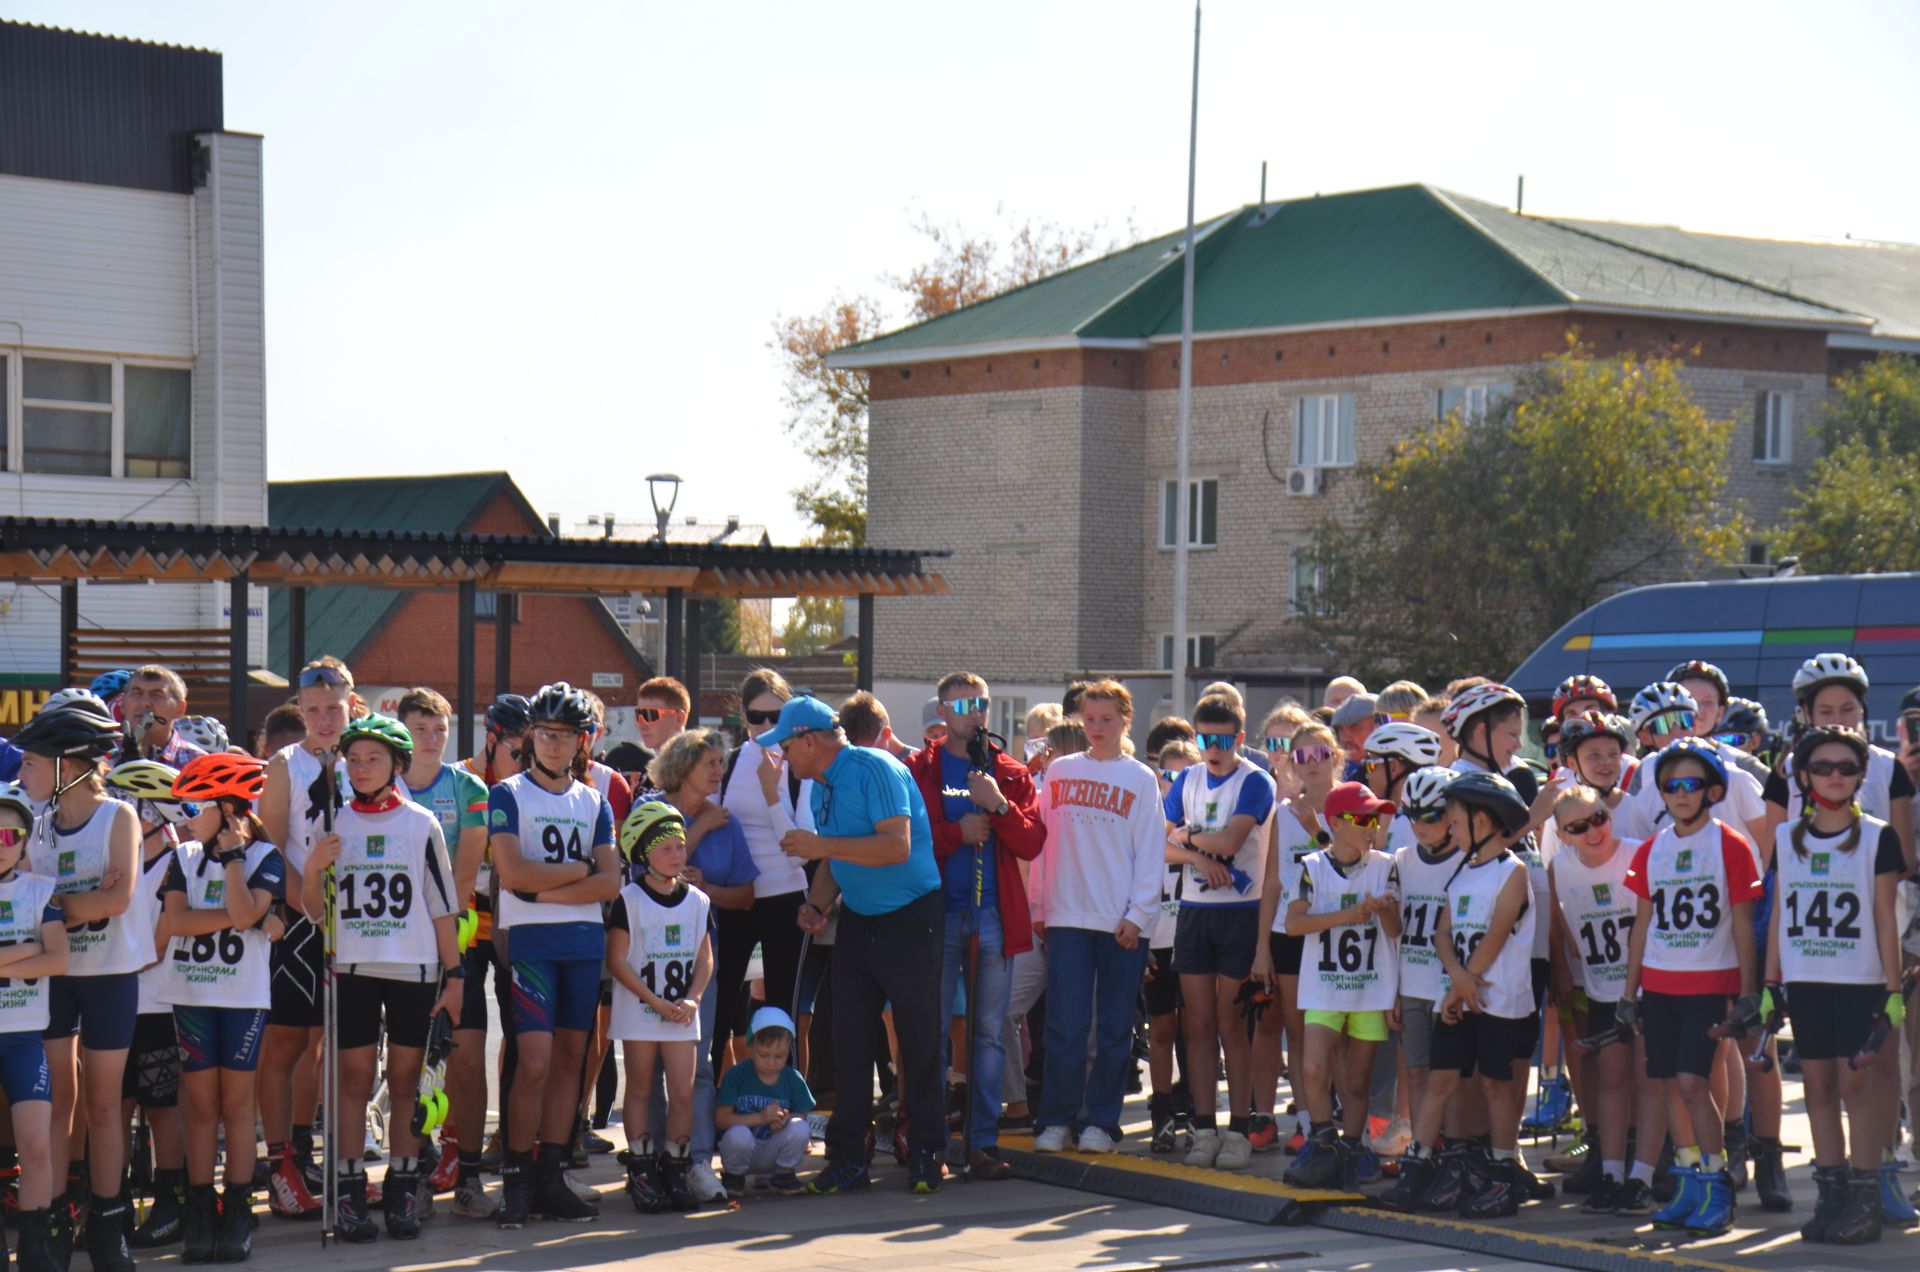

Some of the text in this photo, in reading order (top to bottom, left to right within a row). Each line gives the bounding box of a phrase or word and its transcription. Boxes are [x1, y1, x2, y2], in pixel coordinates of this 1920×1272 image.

[1050, 778, 1136, 819] MICHIGAN
[542, 824, 583, 863] 94
[340, 872, 413, 919] 139
[1652, 883, 1721, 931] 163
[1786, 890, 1861, 939] 142
[360, 929, 390, 938] ЖИЗНИ
[1318, 927, 1377, 972] 167
[1580, 916, 1636, 965] 187
[187, 974, 218, 984] ЖИЗНИ
